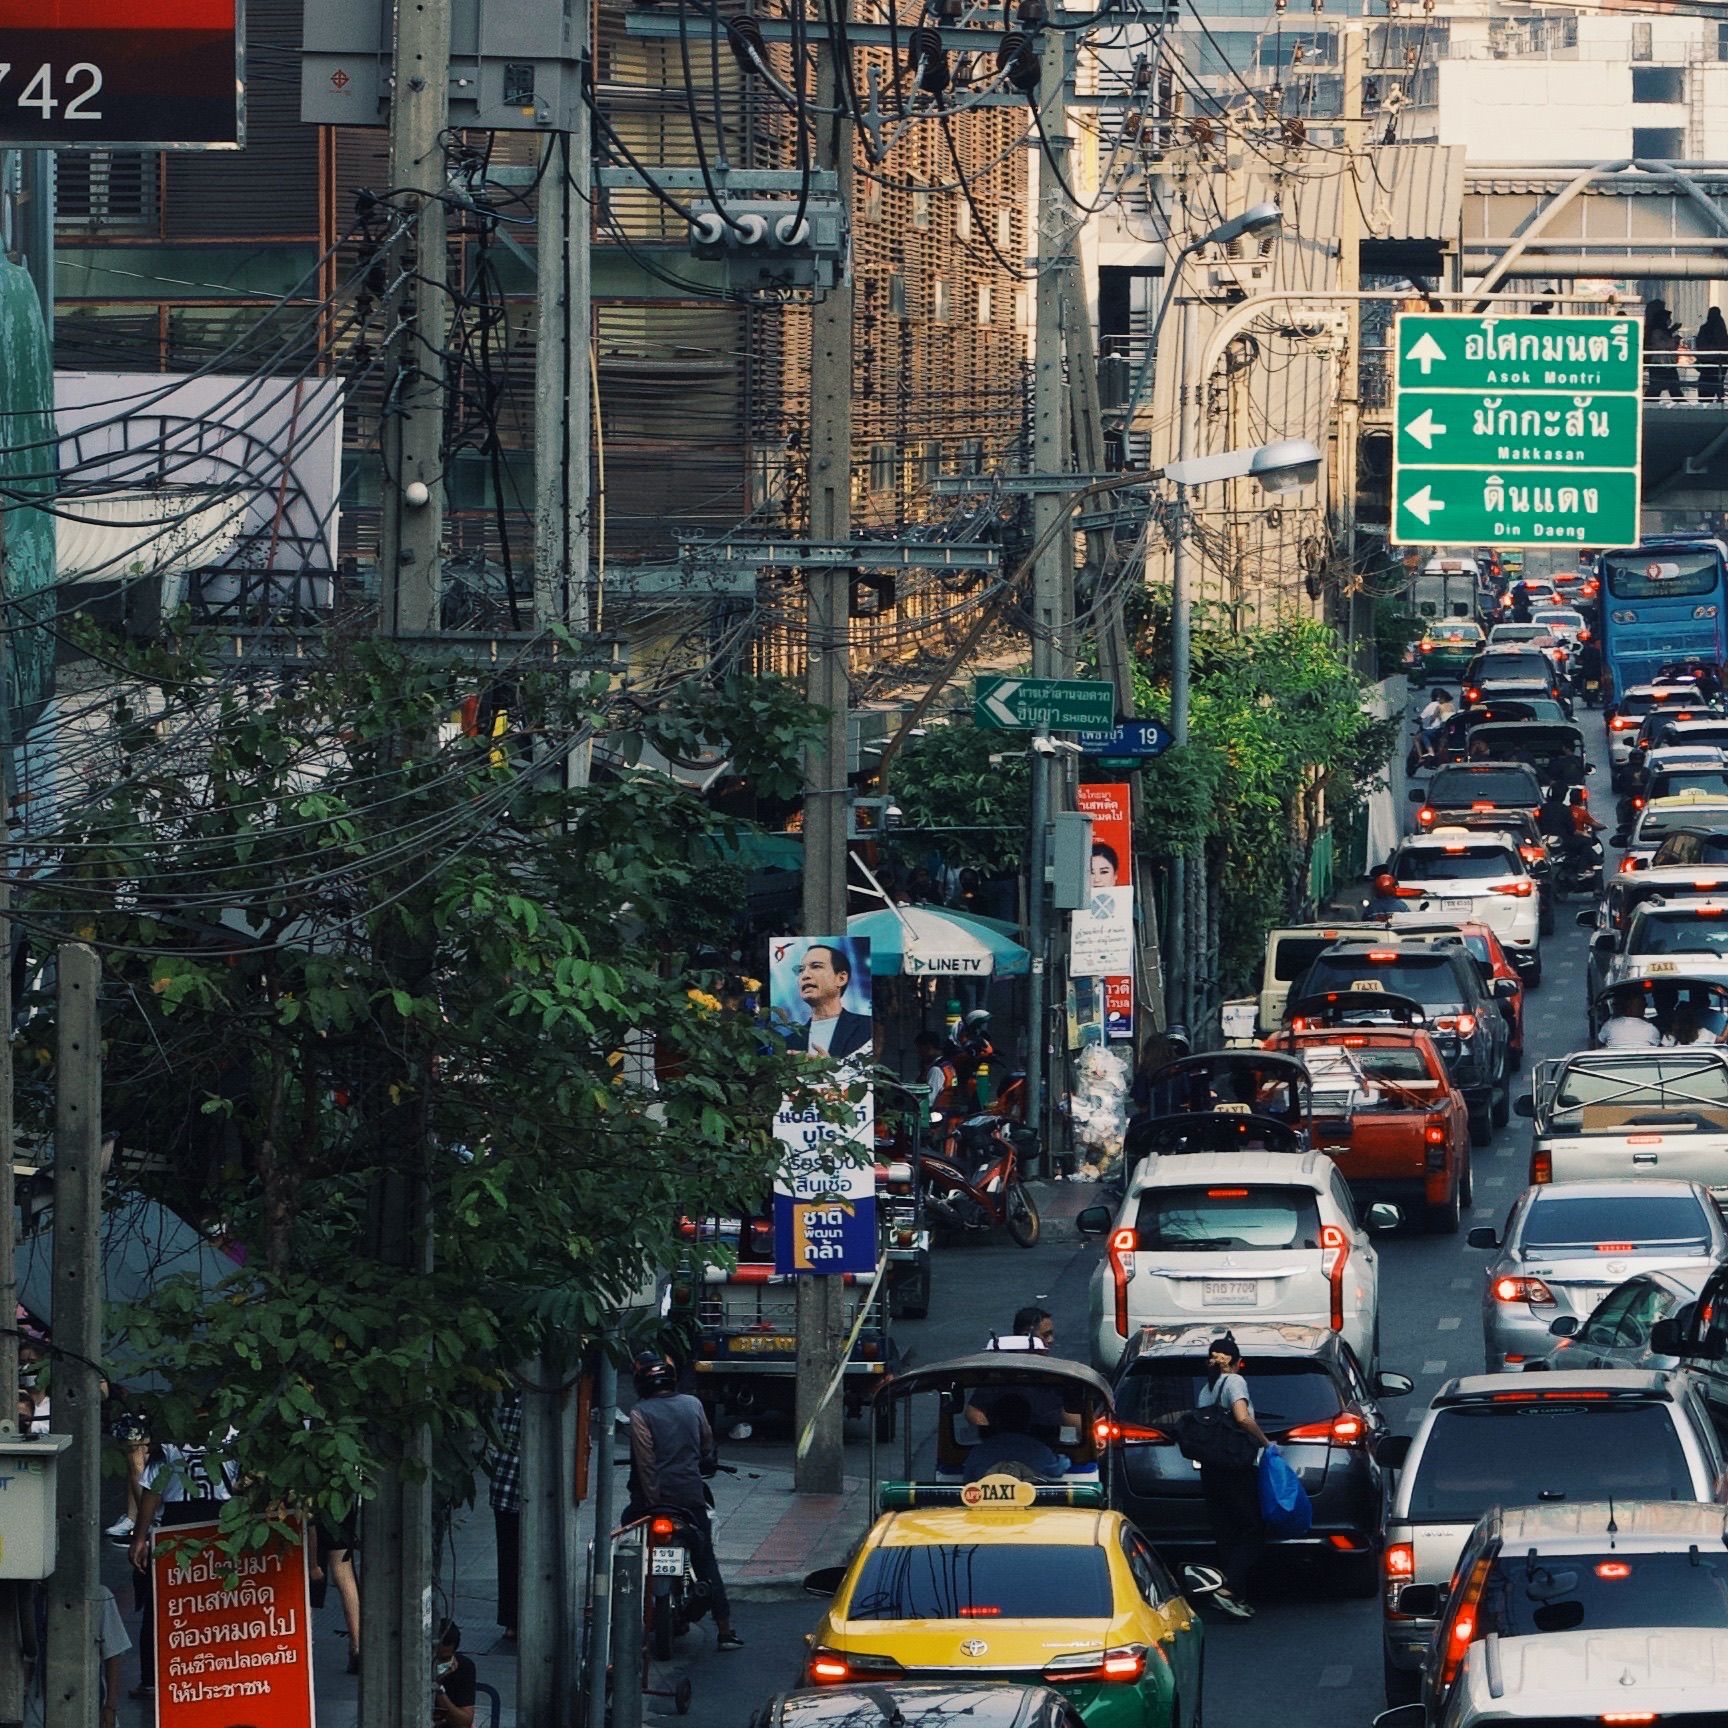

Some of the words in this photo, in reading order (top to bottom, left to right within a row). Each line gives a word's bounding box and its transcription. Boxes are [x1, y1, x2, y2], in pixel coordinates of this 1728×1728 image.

[0, 62, 103, 120] 42
[1465, 319, 1629, 363] อโศกมนตรี
[1487, 371, 1530, 384] Asok
[1544, 371, 1601, 385] Montri
[1472, 397, 1610, 438] มักกะสัน
[1497, 446, 1585, 460] Makkasan
[1483, 475, 1598, 514] ดินแดง
[1494, 523, 1520, 536] Din
[1533, 523, 1585, 540] Daeng
[1062, 713, 1109, 724] SHIBUYA
[1138, 728, 1158, 745] 19
[928, 958, 959, 971] LINE
[962, 958, 981, 971] TV
[1651, 961, 1676, 972] TAXI
[1355, 981, 1378, 992] TAXI
[803, 1207, 843, 1225] ชาติ
[803, 1227, 843, 1239] พัฒนา
[804, 1240, 844, 1259] กล้า
[981, 1484, 1016, 1501] TAXI
[168, 1579, 275, 1617] ยาเสพติด
[168, 1606, 297, 1649] ต้องหมดไป
[168, 1644, 298, 1677] คืนชีวิตปลอดภัย
[168, 1679, 271, 1704] ให้ประชาชน
